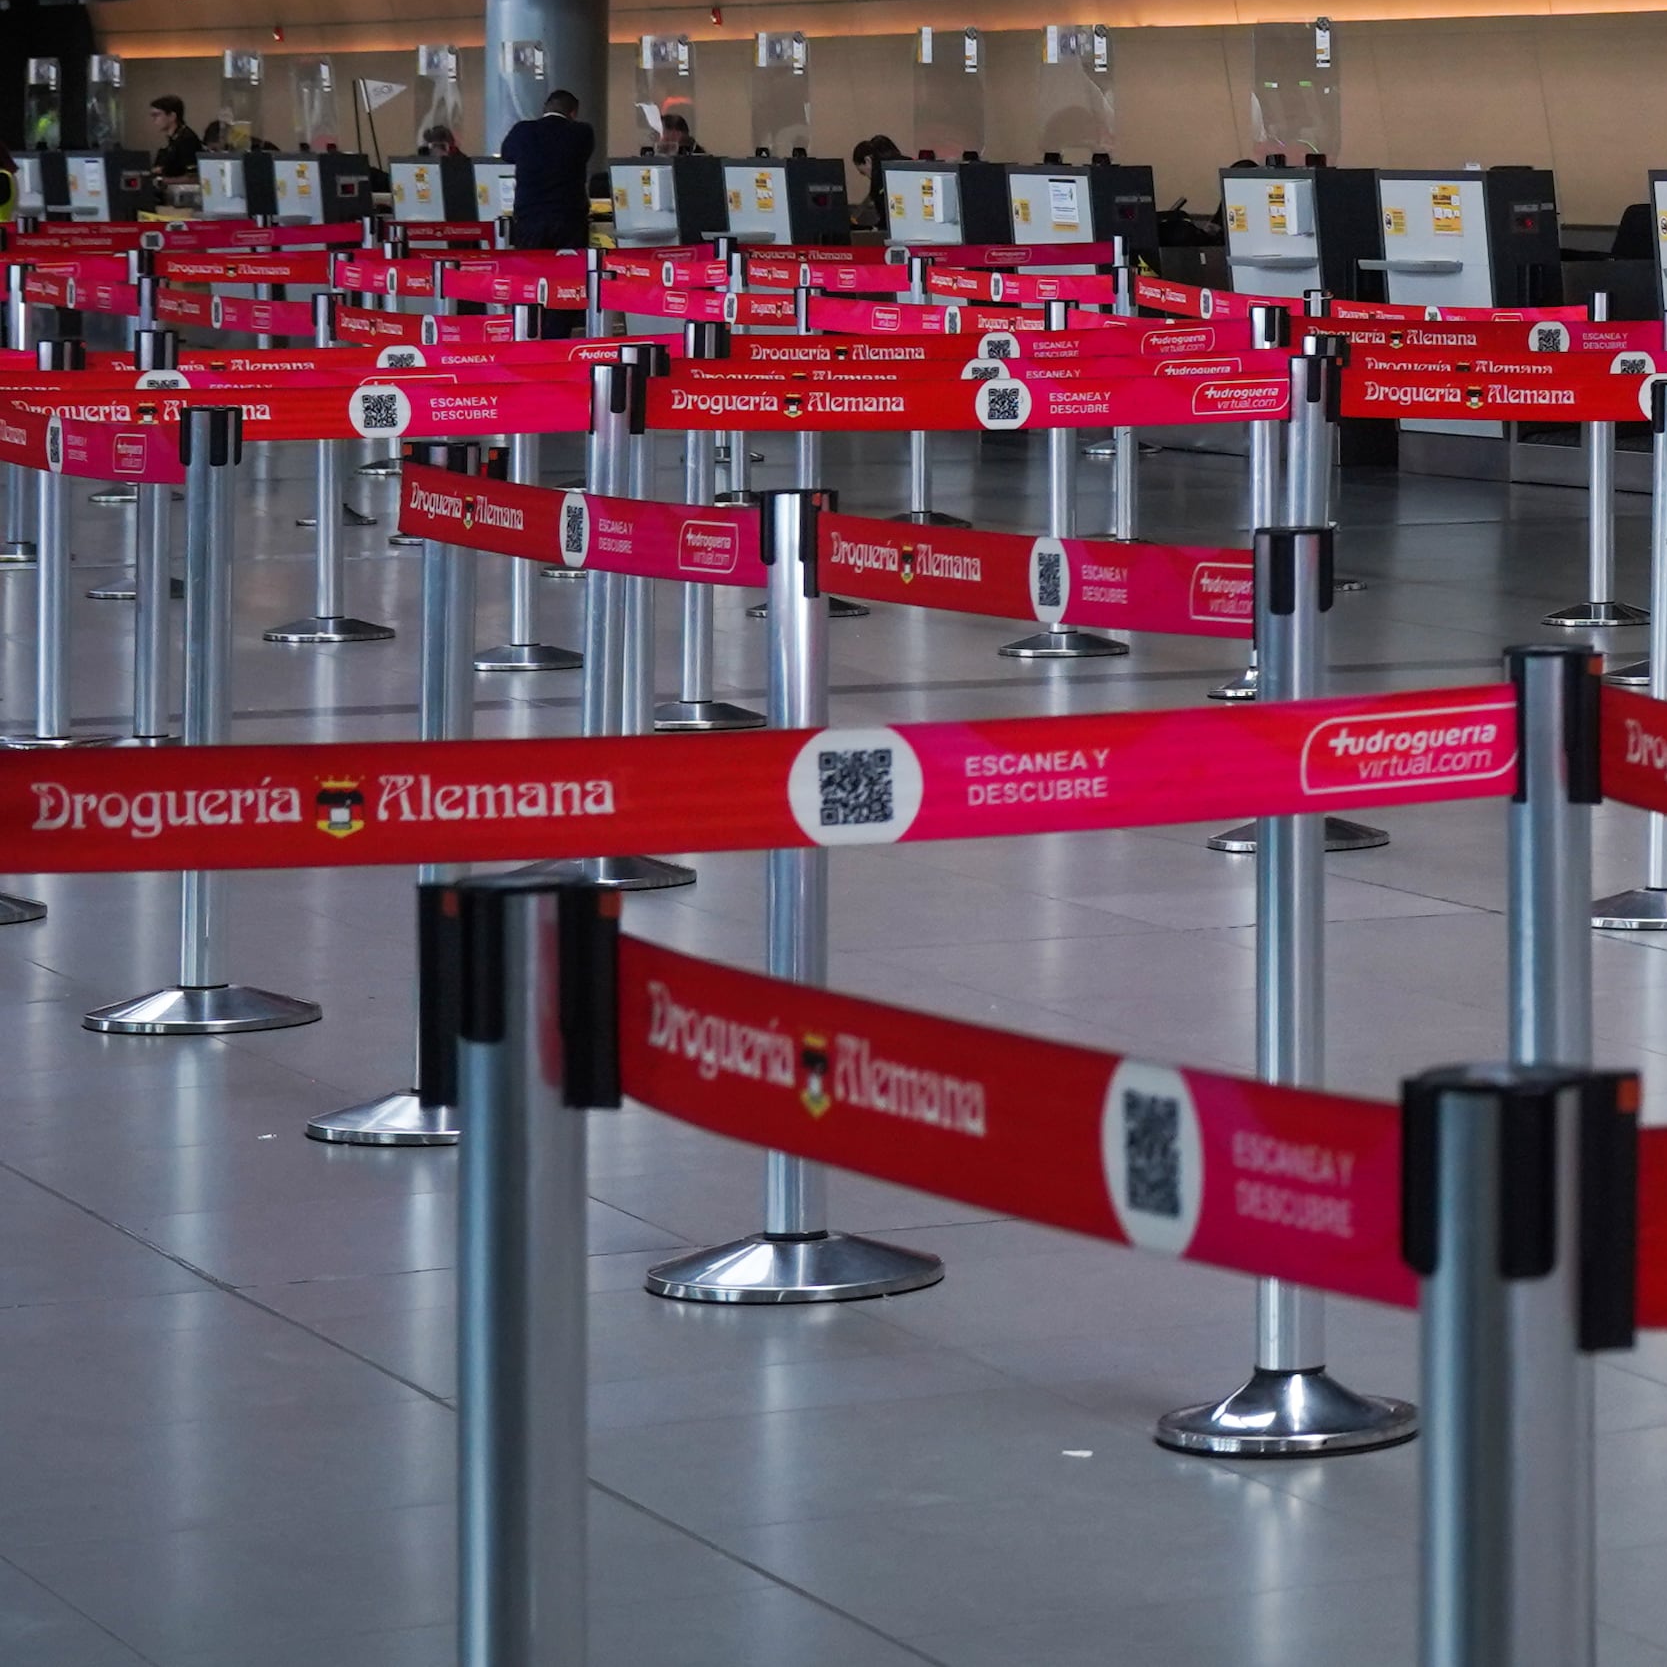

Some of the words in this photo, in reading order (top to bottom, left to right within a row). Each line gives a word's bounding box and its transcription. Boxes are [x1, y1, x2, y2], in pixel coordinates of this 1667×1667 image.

[672, 387, 777, 416] Droguería
[807, 390, 905, 414] Alemana
[1364, 381, 1462, 407] Droguería
[1487, 384, 1575, 405] Alemana
[964, 751, 1088, 779] ESCANEA
[1090, 748, 1110, 770] Y
[31, 776, 302, 838] Droguería
[376, 771, 616, 823] Alemana
[967, 776, 1109, 807] DESCUBRE
[835, 1033, 987, 1137] Alemana
